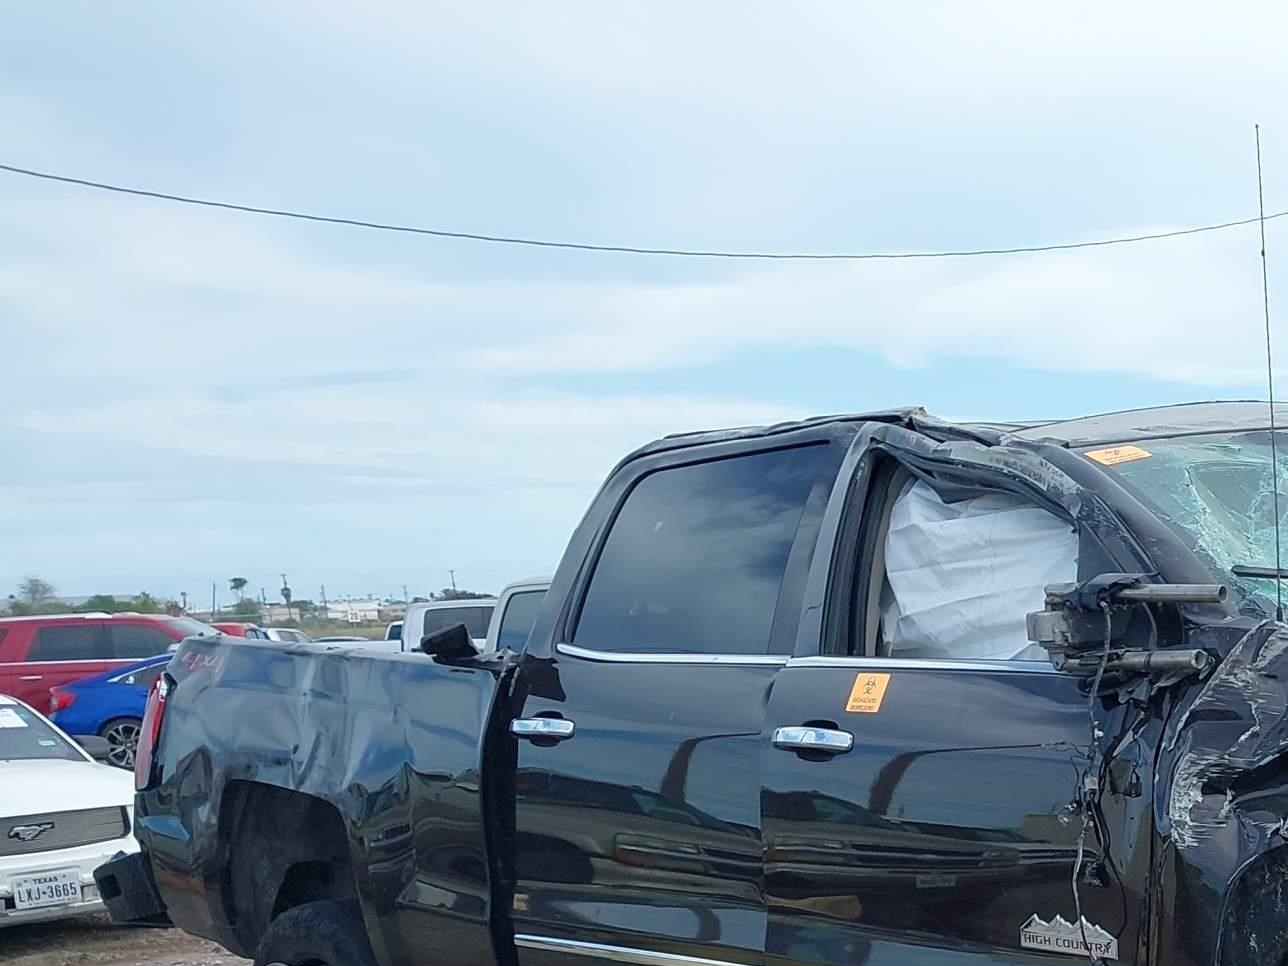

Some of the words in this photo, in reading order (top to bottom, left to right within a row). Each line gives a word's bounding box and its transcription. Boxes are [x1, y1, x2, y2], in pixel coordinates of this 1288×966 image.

[32, 876, 58, 884] TEXAS
[1023, 933, 1051, 945] HIGH
[1055, 937, 1113, 954] COUNTRY
